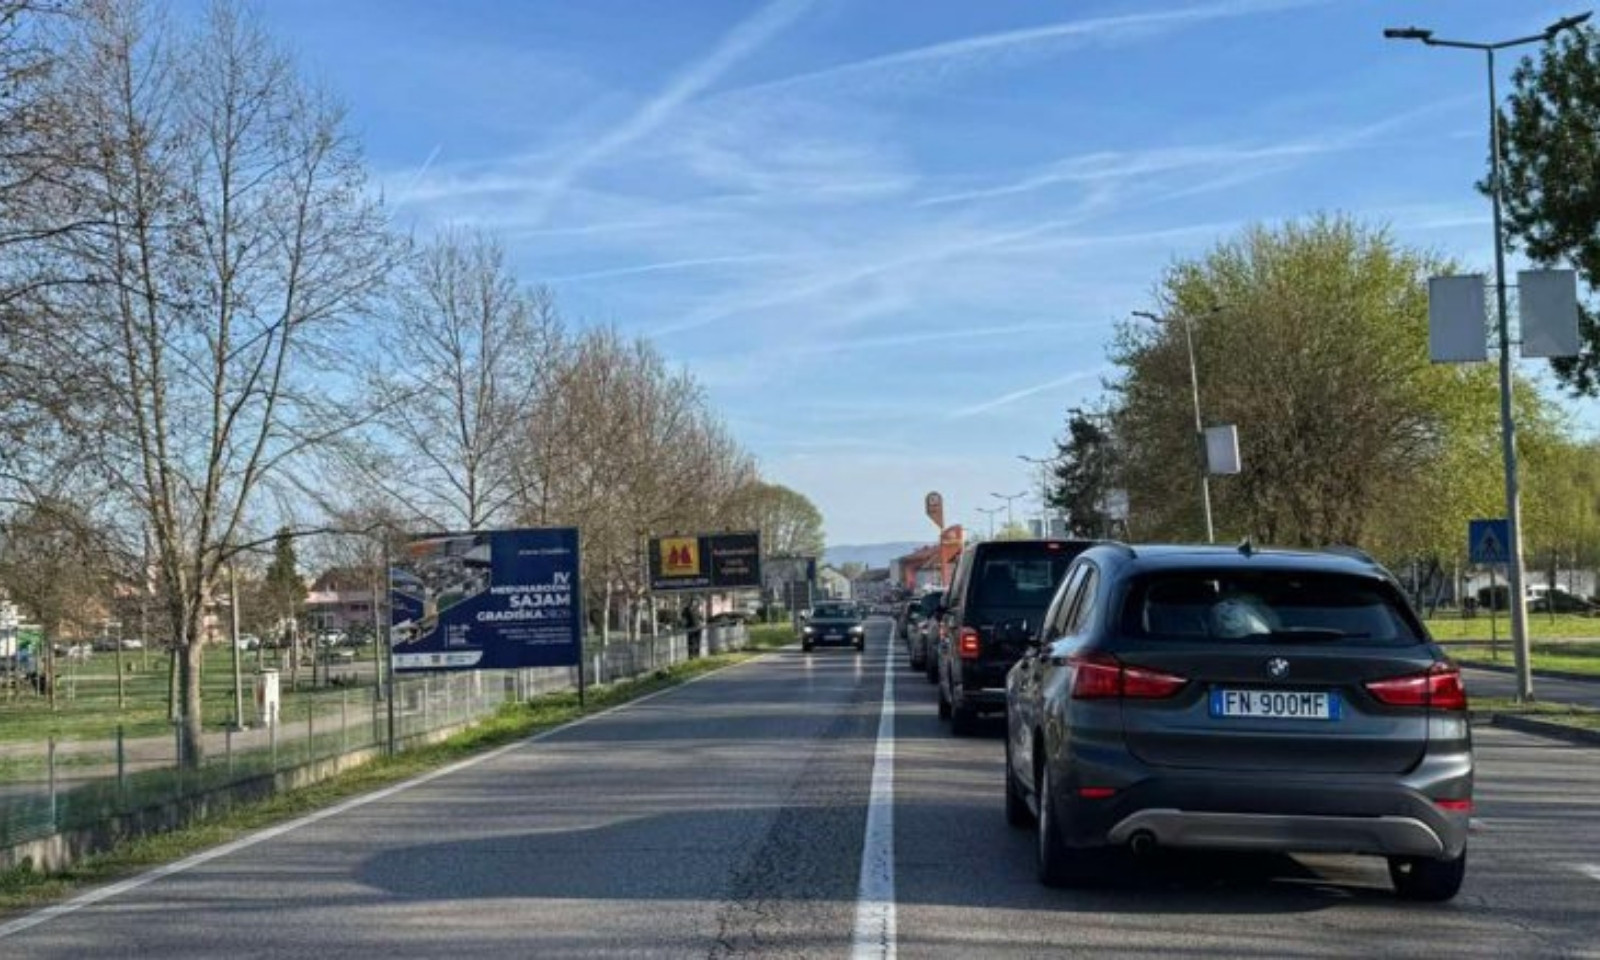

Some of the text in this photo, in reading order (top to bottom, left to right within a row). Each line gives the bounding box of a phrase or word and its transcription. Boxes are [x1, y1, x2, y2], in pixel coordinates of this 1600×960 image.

[554, 571, 570, 585] IV
[509, 593, 571, 608] SAJAM
[1226, 692, 1324, 715] FN 900MF
